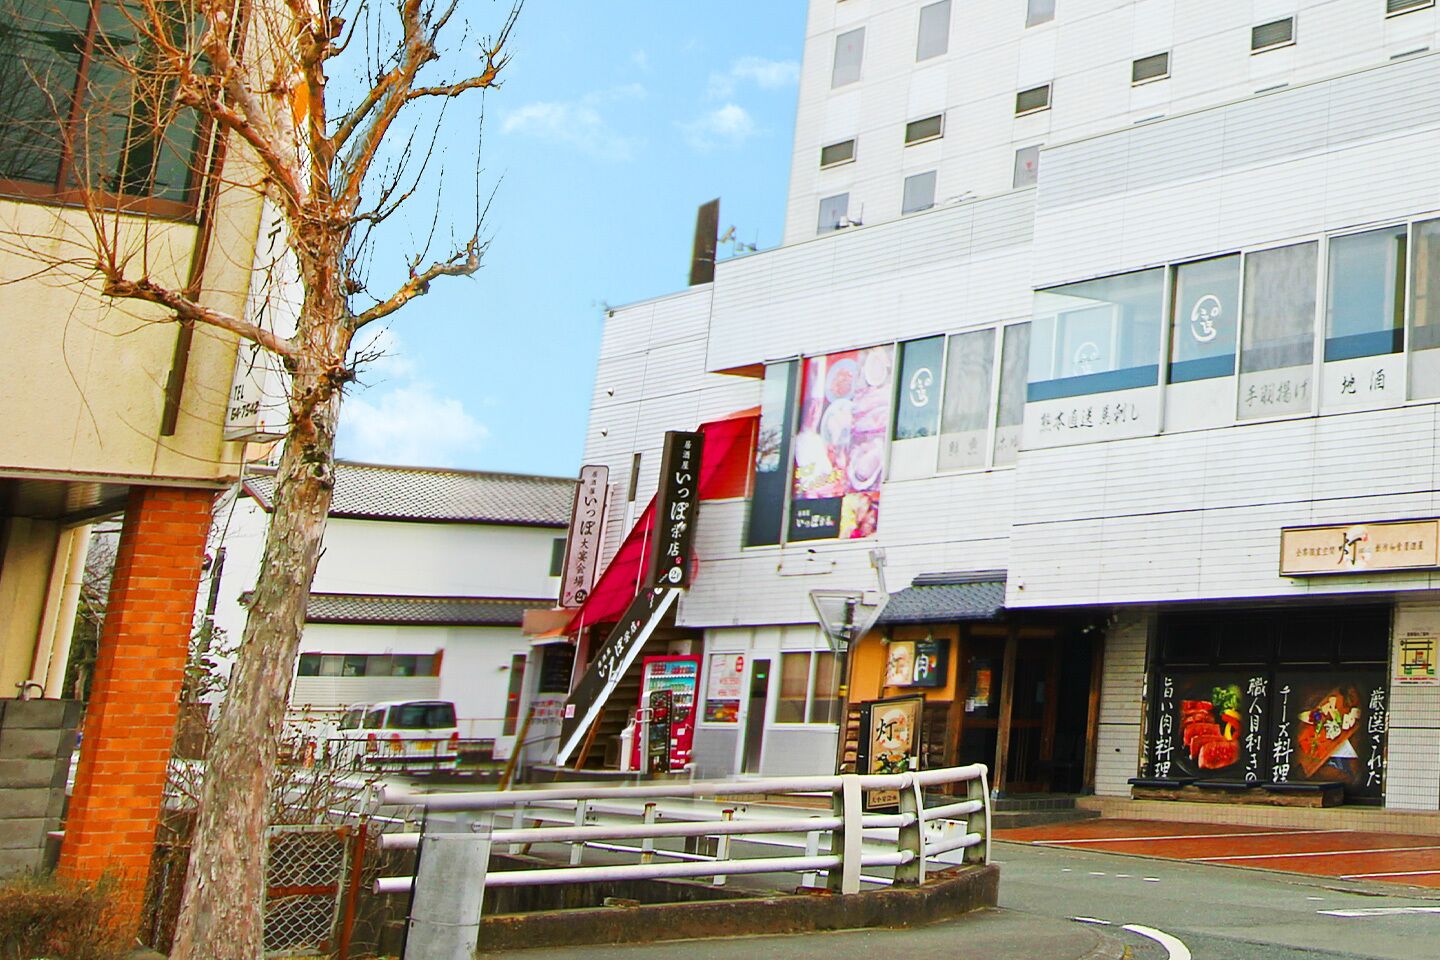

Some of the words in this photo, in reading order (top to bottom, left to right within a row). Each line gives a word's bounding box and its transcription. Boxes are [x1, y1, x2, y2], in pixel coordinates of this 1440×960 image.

[1340, 369, 1386, 395] 地酒
[876, 719, 897, 742] 灯
[1154, 677, 1175, 778] 旨い肉料理
[1245, 677, 1267, 782] 職人目利きの
[1273, 685, 1293, 783] チーズ料理
[1366, 686, 1385, 787] 厳選された
